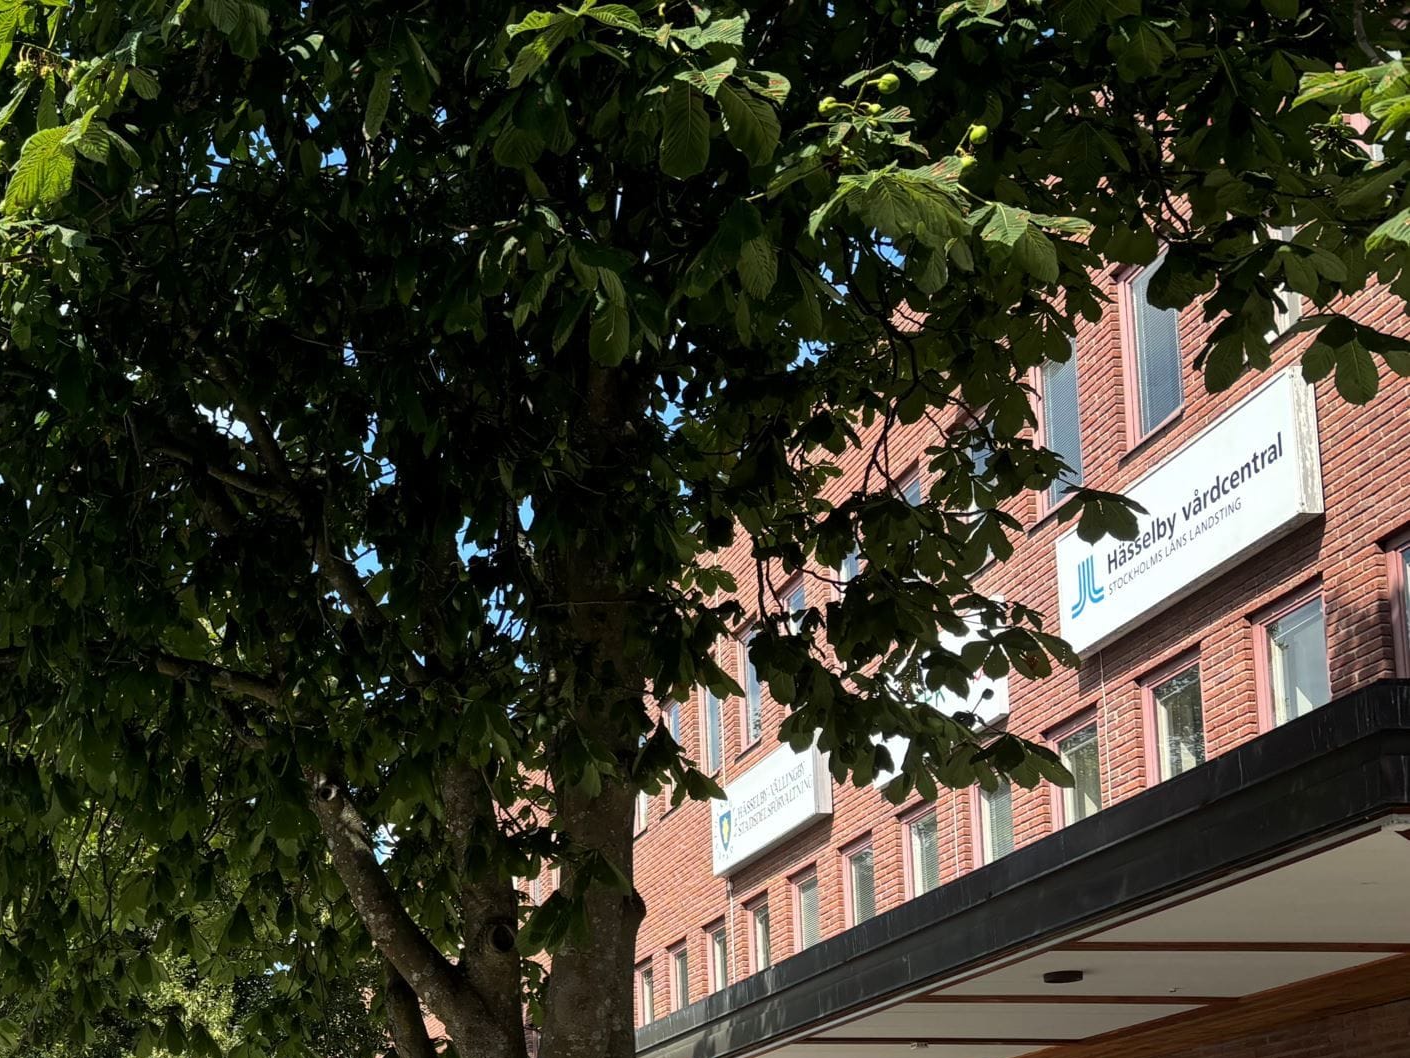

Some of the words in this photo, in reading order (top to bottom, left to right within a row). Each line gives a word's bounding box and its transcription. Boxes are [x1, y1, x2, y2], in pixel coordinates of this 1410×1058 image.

[1107, 511, 1177, 575] Hässelby
[1181, 432, 1283, 521] vårdcentral
[1108, 548, 1163, 596] STOCKHOLMS
[1189, 496, 1242, 541] LANDSTING
